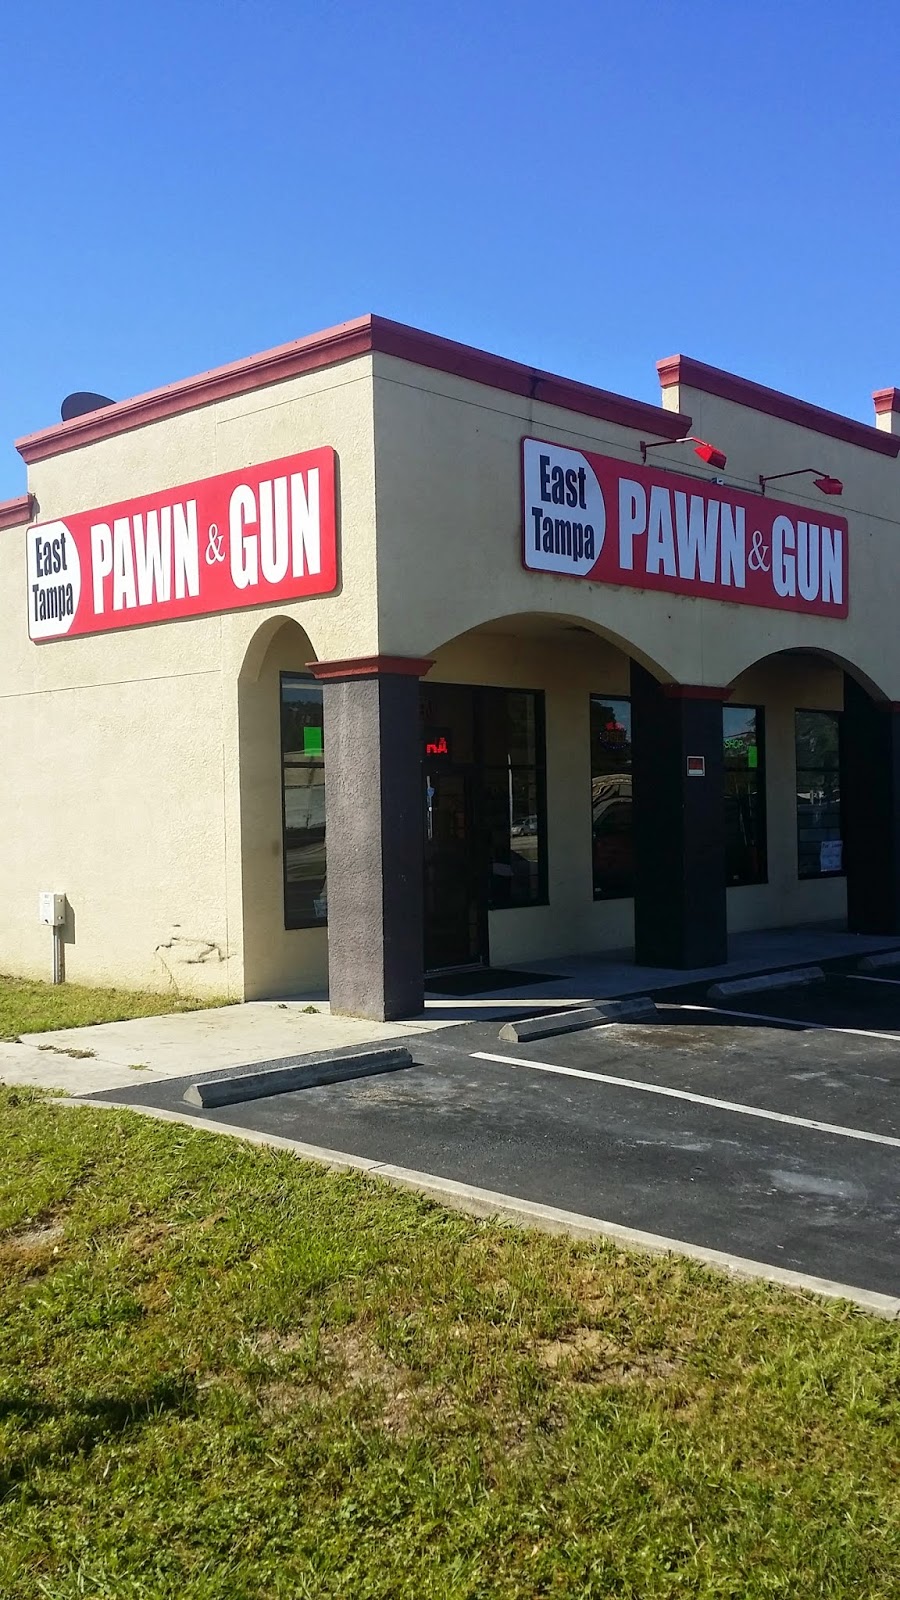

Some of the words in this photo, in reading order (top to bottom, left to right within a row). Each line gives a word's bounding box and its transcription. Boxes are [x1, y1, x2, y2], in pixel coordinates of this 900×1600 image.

[539, 454, 587, 510] East
[35, 532, 68, 578] East
[90, 499, 200, 615] PAWN
[205, 523, 226, 565] &
[228, 467, 321, 589] GUN
[531, 506, 595, 562] Tampa
[618, 477, 746, 589] PAWN
[748, 530, 770, 572] &
[771, 515, 843, 605] GUN
[32, 582, 74, 622] Tampa
[724, 738, 744, 750] SHOP
